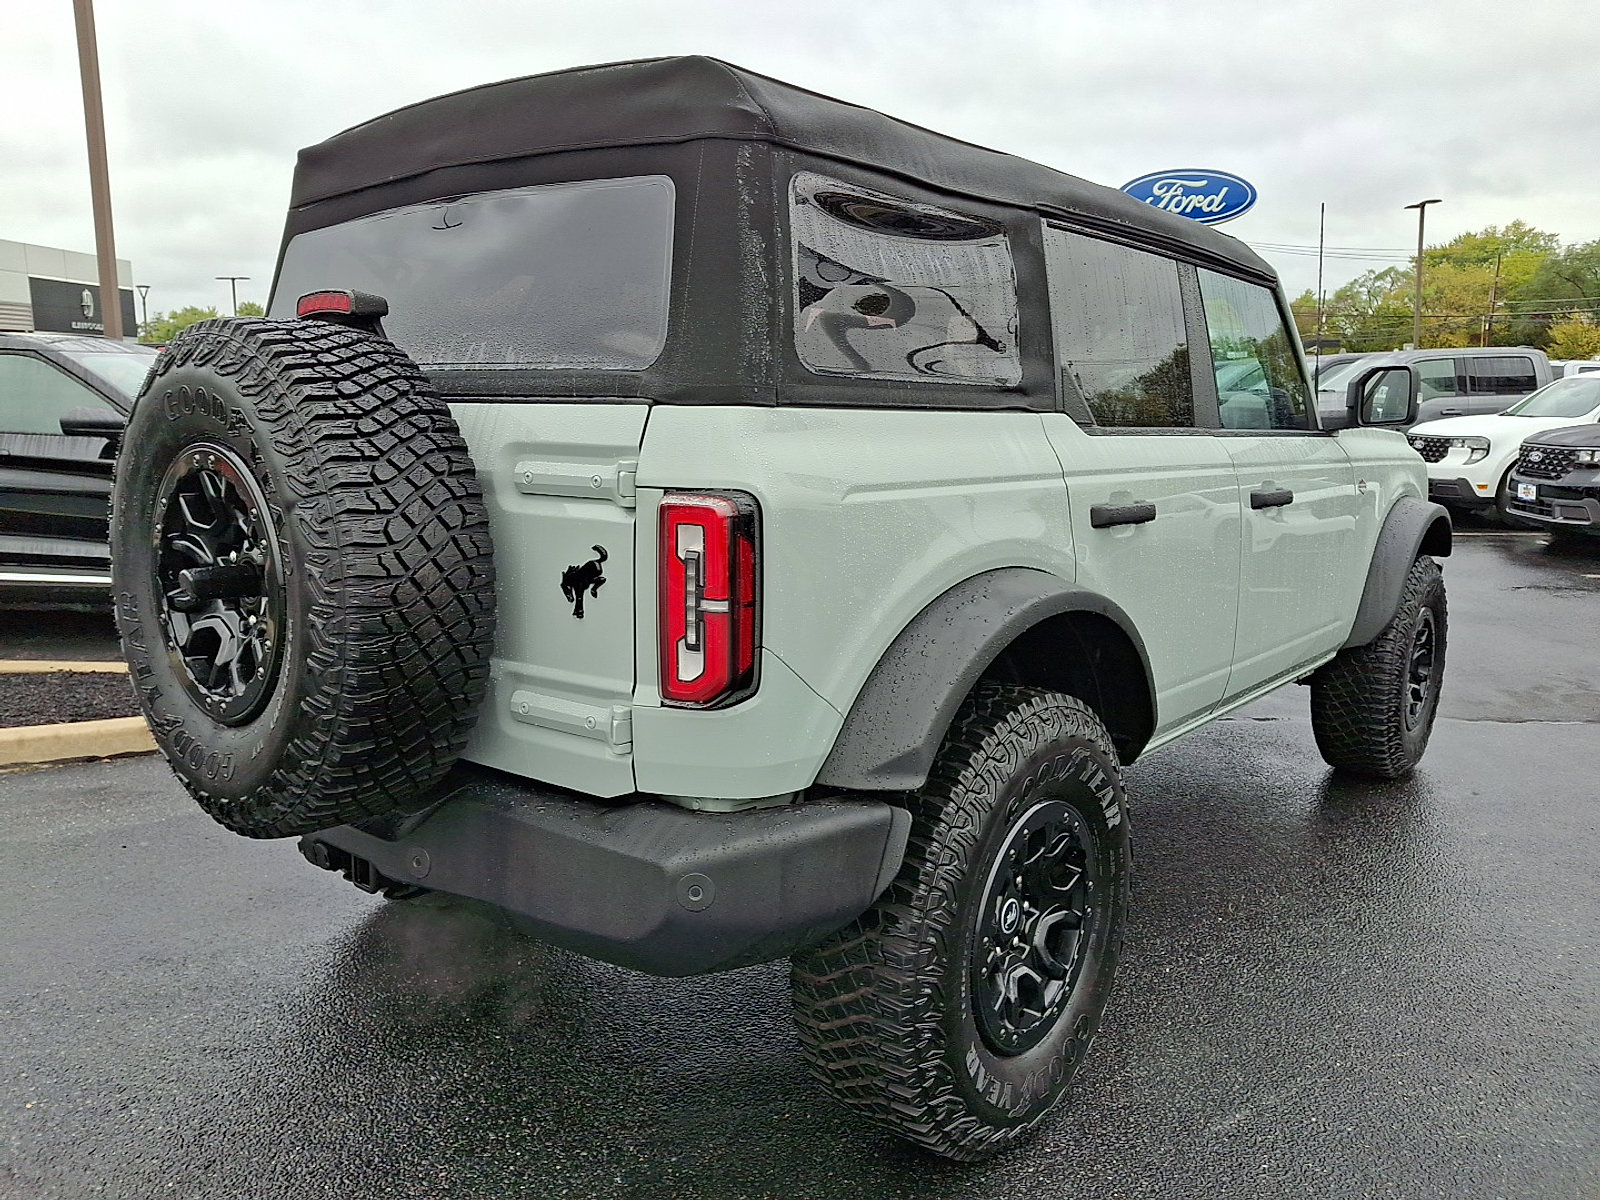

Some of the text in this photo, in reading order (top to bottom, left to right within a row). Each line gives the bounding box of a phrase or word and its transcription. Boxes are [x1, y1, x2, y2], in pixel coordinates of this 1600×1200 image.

[1145, 178, 1229, 214] Ford
[1004, 746, 1122, 830] GOODYEAR
[964, 1012, 1090, 1119] GOODYEAR
